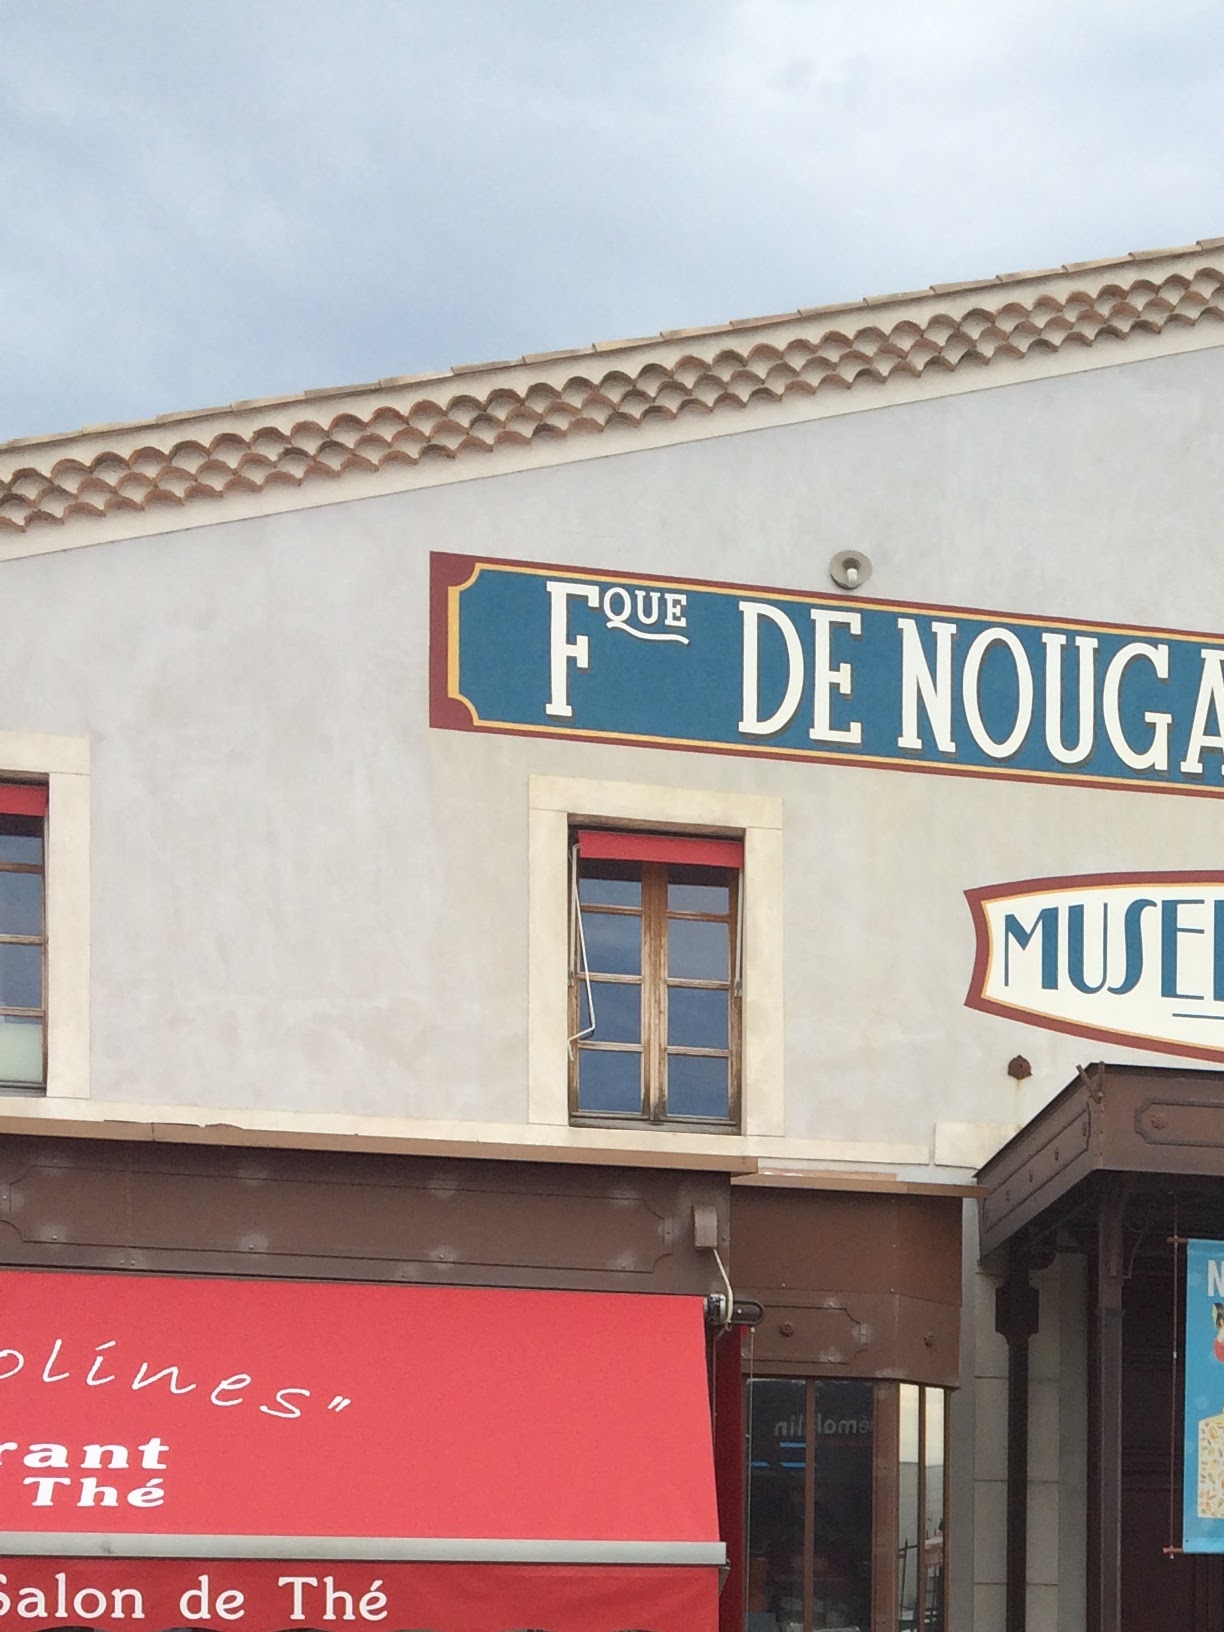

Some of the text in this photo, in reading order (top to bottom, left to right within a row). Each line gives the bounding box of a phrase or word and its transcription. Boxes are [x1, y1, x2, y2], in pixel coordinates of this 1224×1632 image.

[737, 599, 863, 746] DE
[22, 1476, 166, 1508] Thé
[179, 1575, 245, 1621] de
[278, 1575, 389, 1622] Thé
